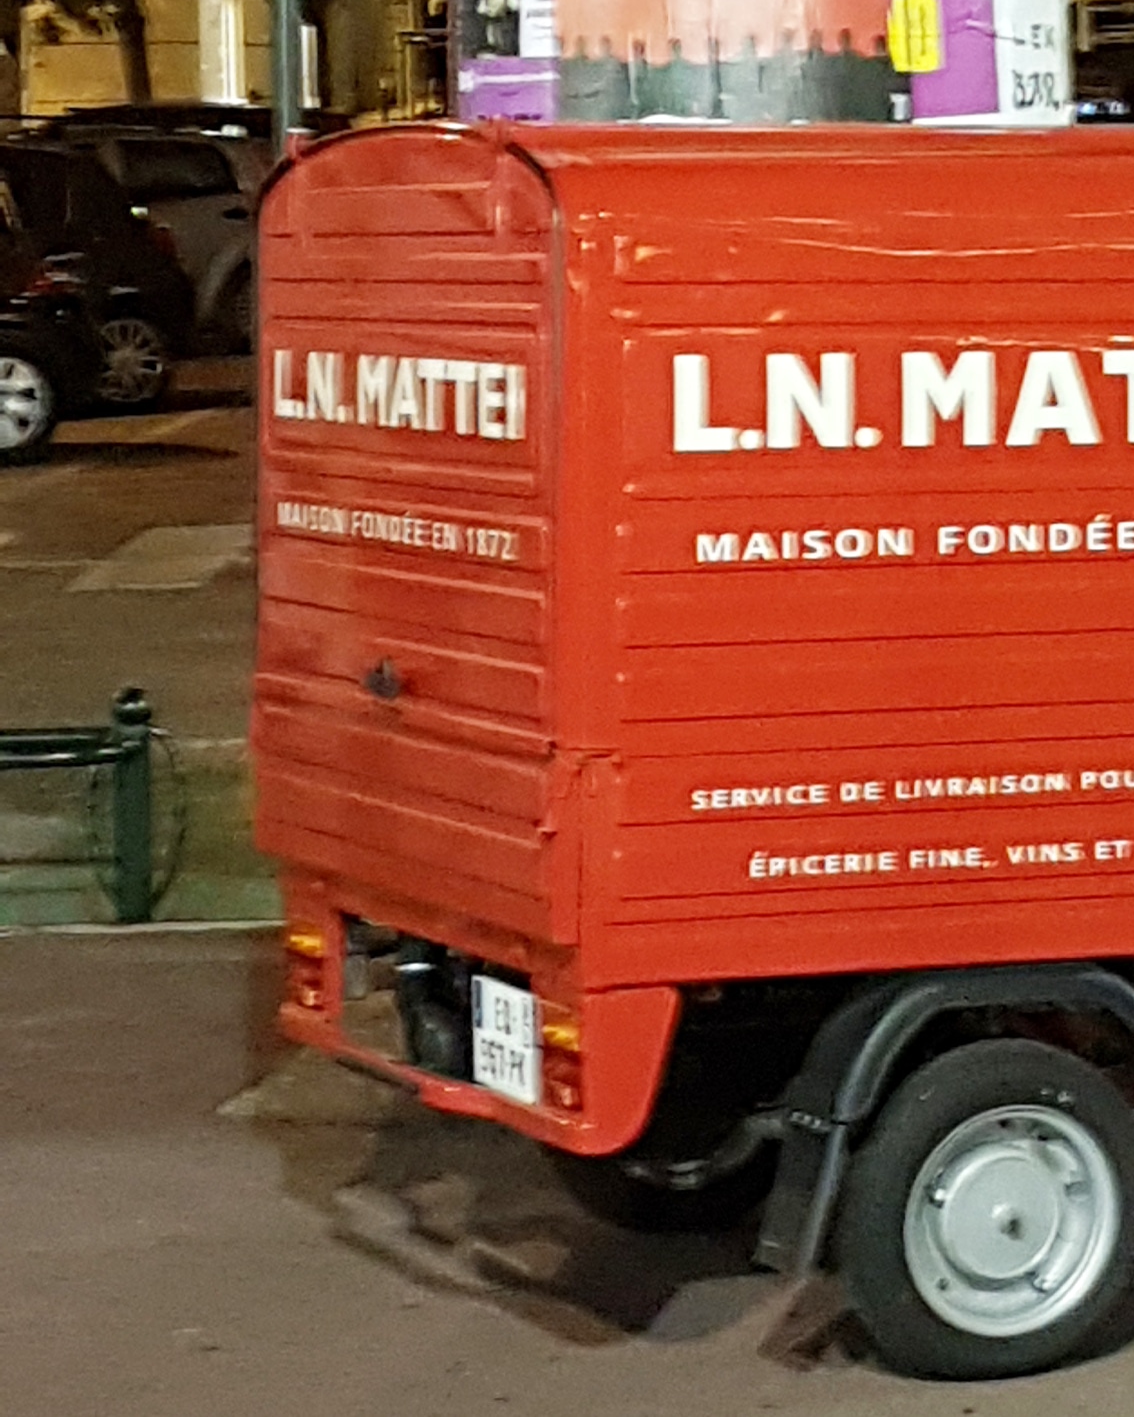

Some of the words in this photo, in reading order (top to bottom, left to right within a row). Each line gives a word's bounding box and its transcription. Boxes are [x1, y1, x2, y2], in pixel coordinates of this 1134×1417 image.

[274, 350, 347, 423] L.N.
[357, 354, 526, 441] MATTEI
[673, 351, 883, 453] L.N.
[277, 501, 348, 535] MAISON
[351, 509, 431, 547] FONDÉE
[432, 521, 460, 551] EN
[467, 527, 519, 561] 1872
[696, 527, 914, 563] MAISON
[691, 783, 831, 810] SERVICE
[839, 781, 885, 804] DE
[895, 772, 1071, 801] LIVRAISON
[749, 850, 899, 878] ÉPICERIE
[1007, 841, 1086, 865] VINS
[1095, 839, 1133, 861] ET
